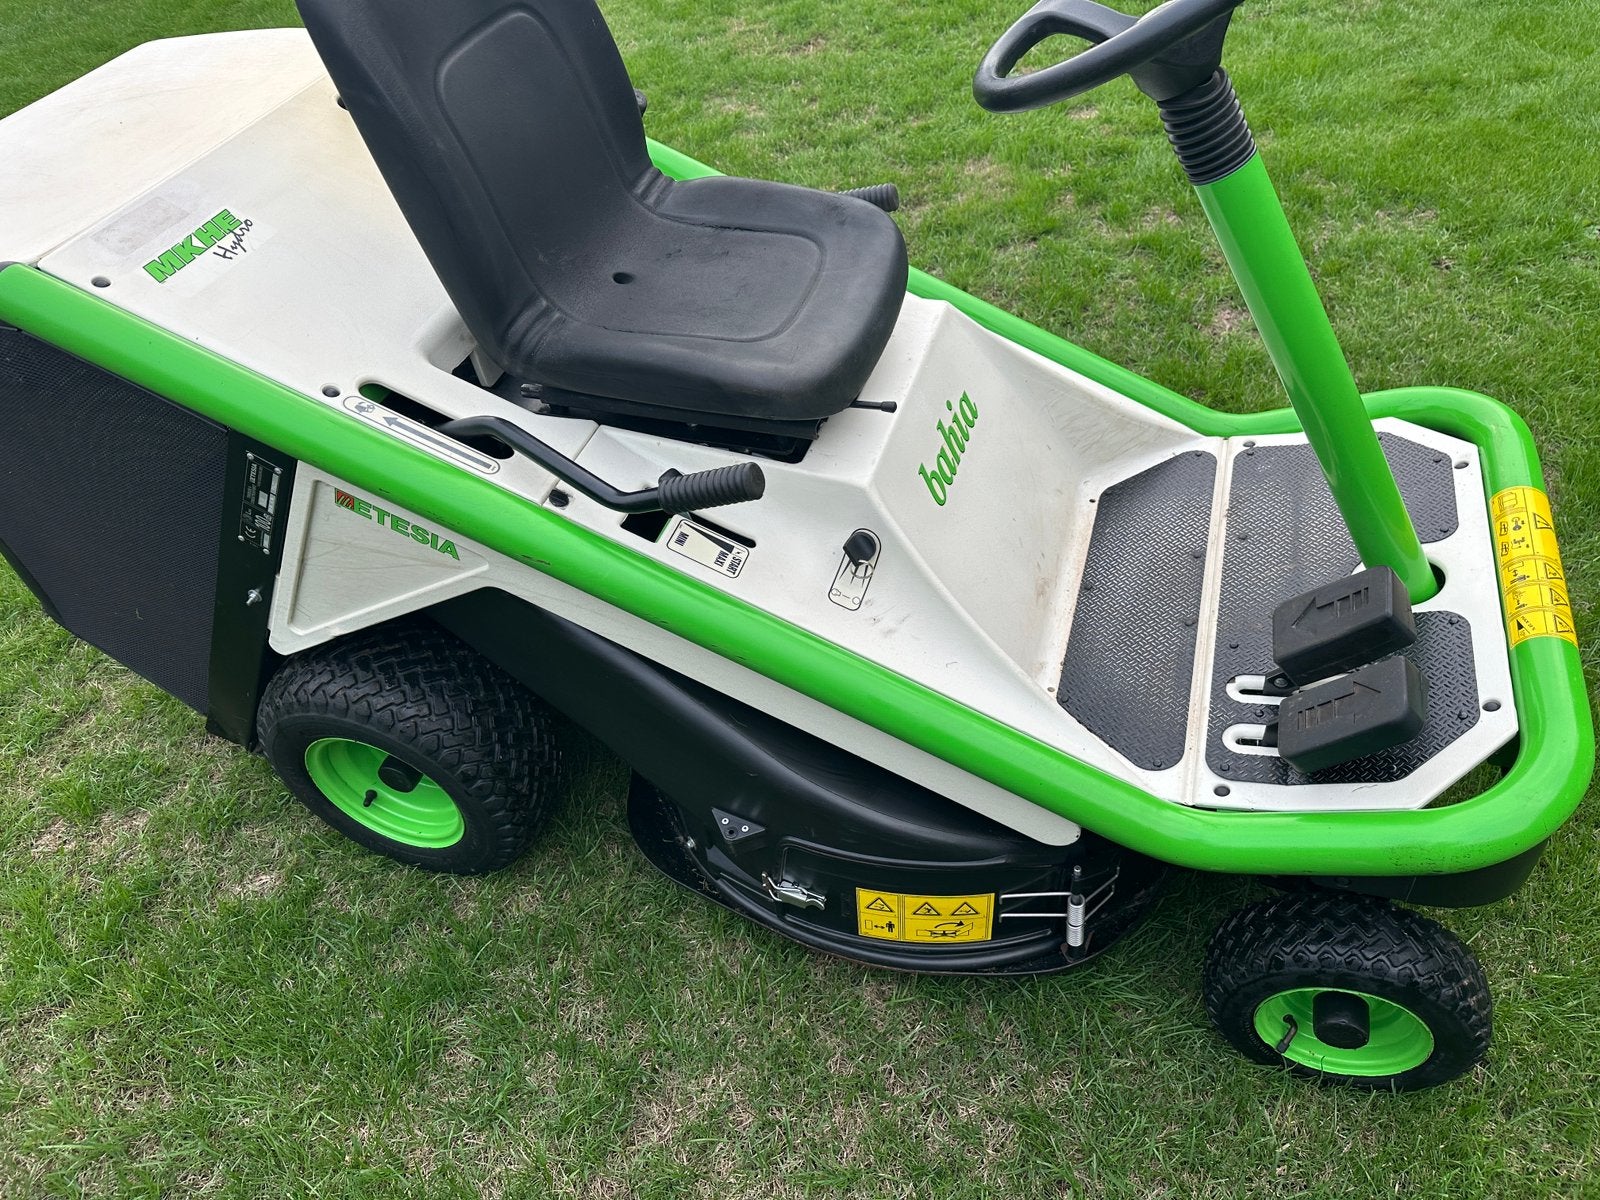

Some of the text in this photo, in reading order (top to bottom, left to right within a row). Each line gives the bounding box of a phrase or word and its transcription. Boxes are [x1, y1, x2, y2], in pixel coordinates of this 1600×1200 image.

[143, 208, 243, 283] MKHE
[212, 218, 254, 260] Hydro
[917, 389, 979, 507] bahia
[352, 496, 460, 561] ETESIA
[674, 531, 690, 547] MINI
[714, 550, 730, 568] MAXI
[726, 556, 742, 576] START
